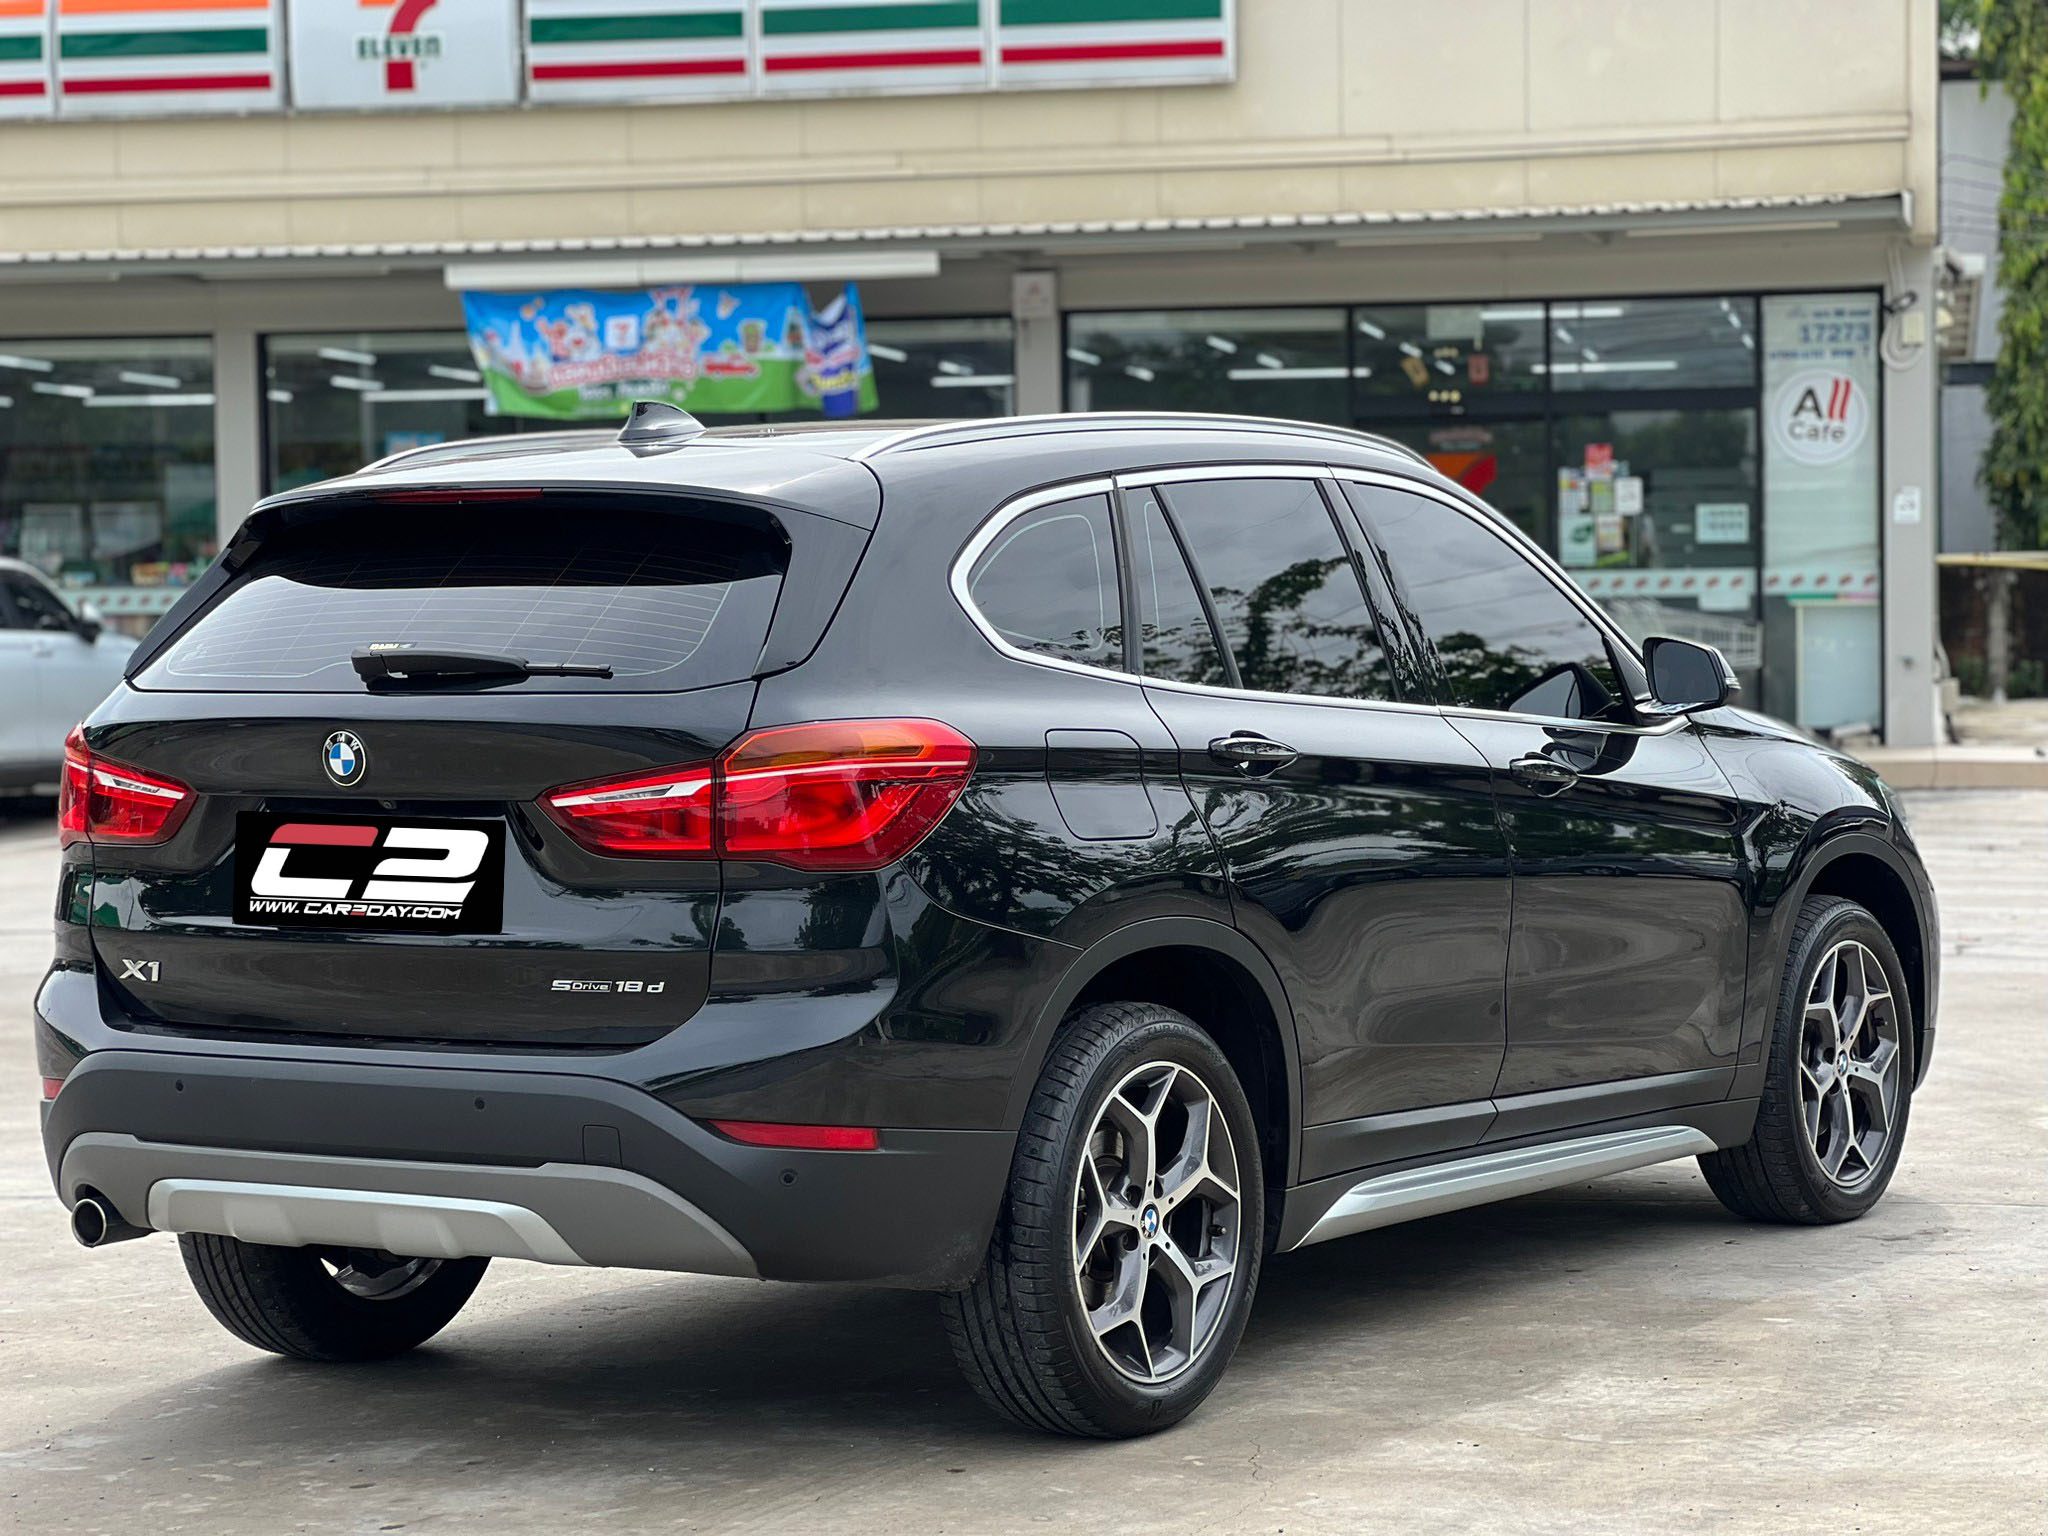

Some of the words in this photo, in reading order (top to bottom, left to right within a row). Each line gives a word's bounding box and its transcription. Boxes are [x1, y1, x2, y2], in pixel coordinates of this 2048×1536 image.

[1792, 376, 1852, 421] All
[325, 732, 361, 752] BMW
[119, 958, 160, 982] X1
